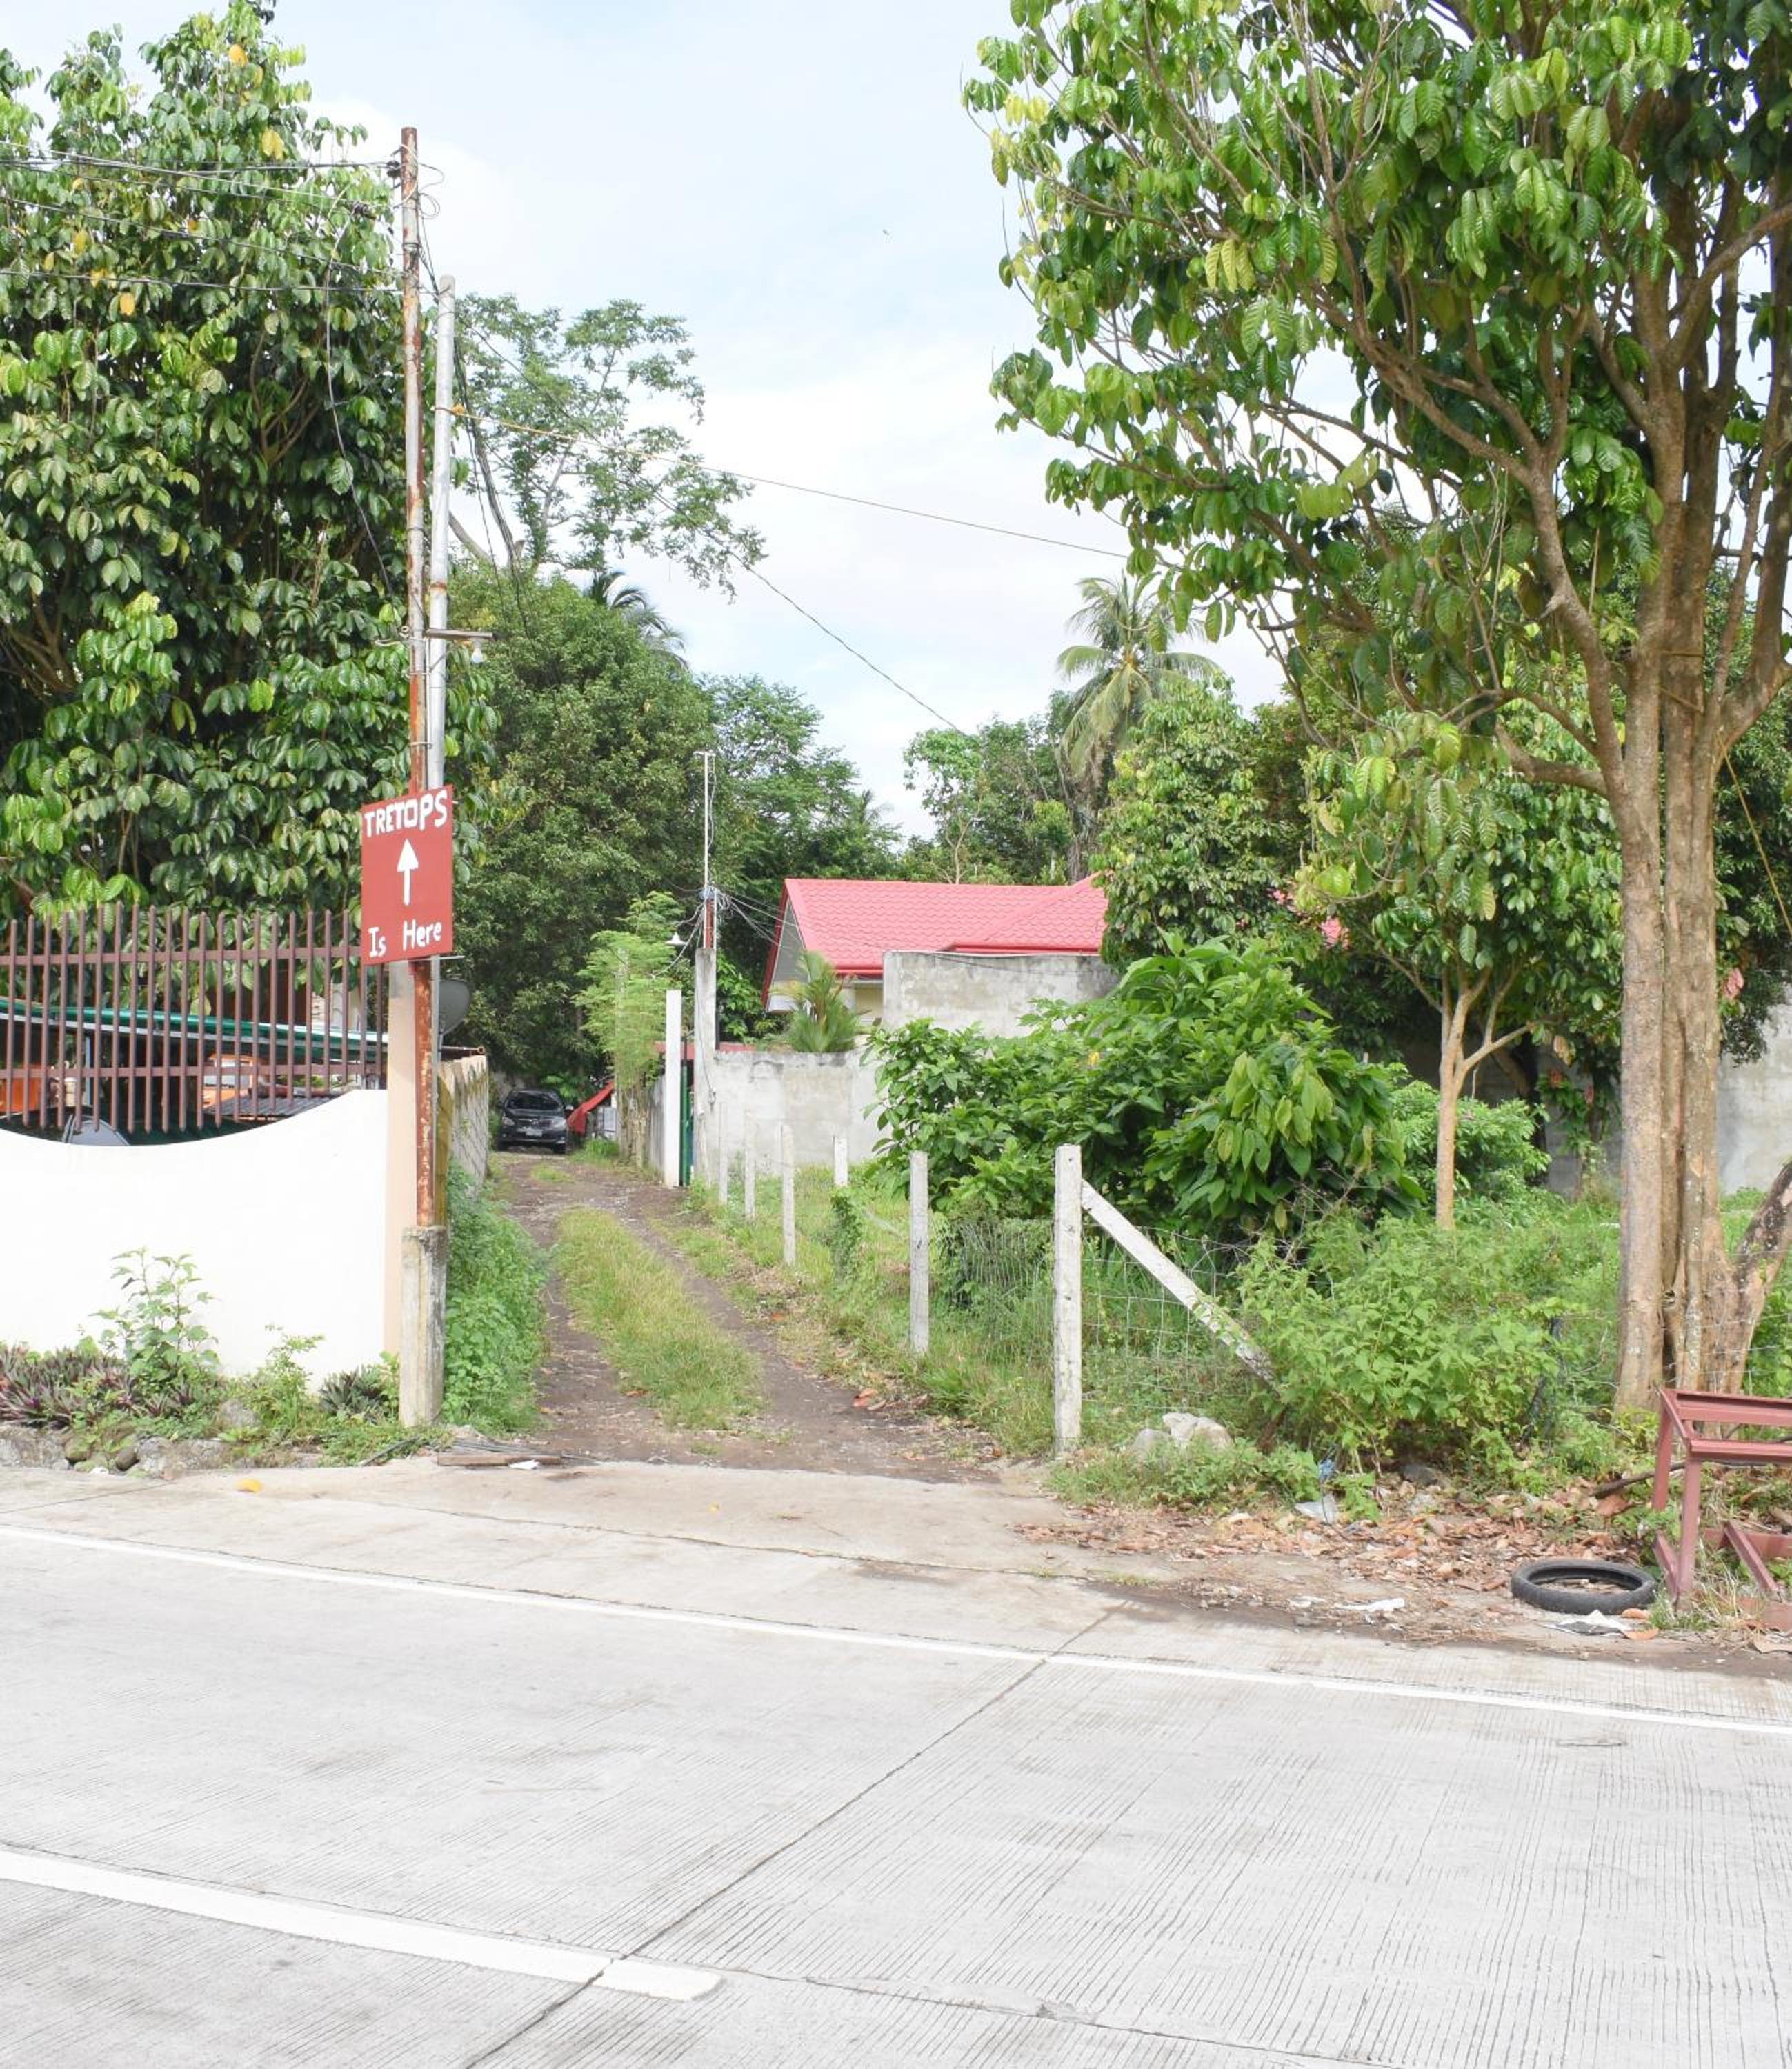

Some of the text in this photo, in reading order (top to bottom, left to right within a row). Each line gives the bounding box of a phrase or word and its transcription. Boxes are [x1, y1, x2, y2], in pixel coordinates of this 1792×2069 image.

[364, 790, 448, 837] TRETOPS
[368, 919, 442, 957] Is Here
